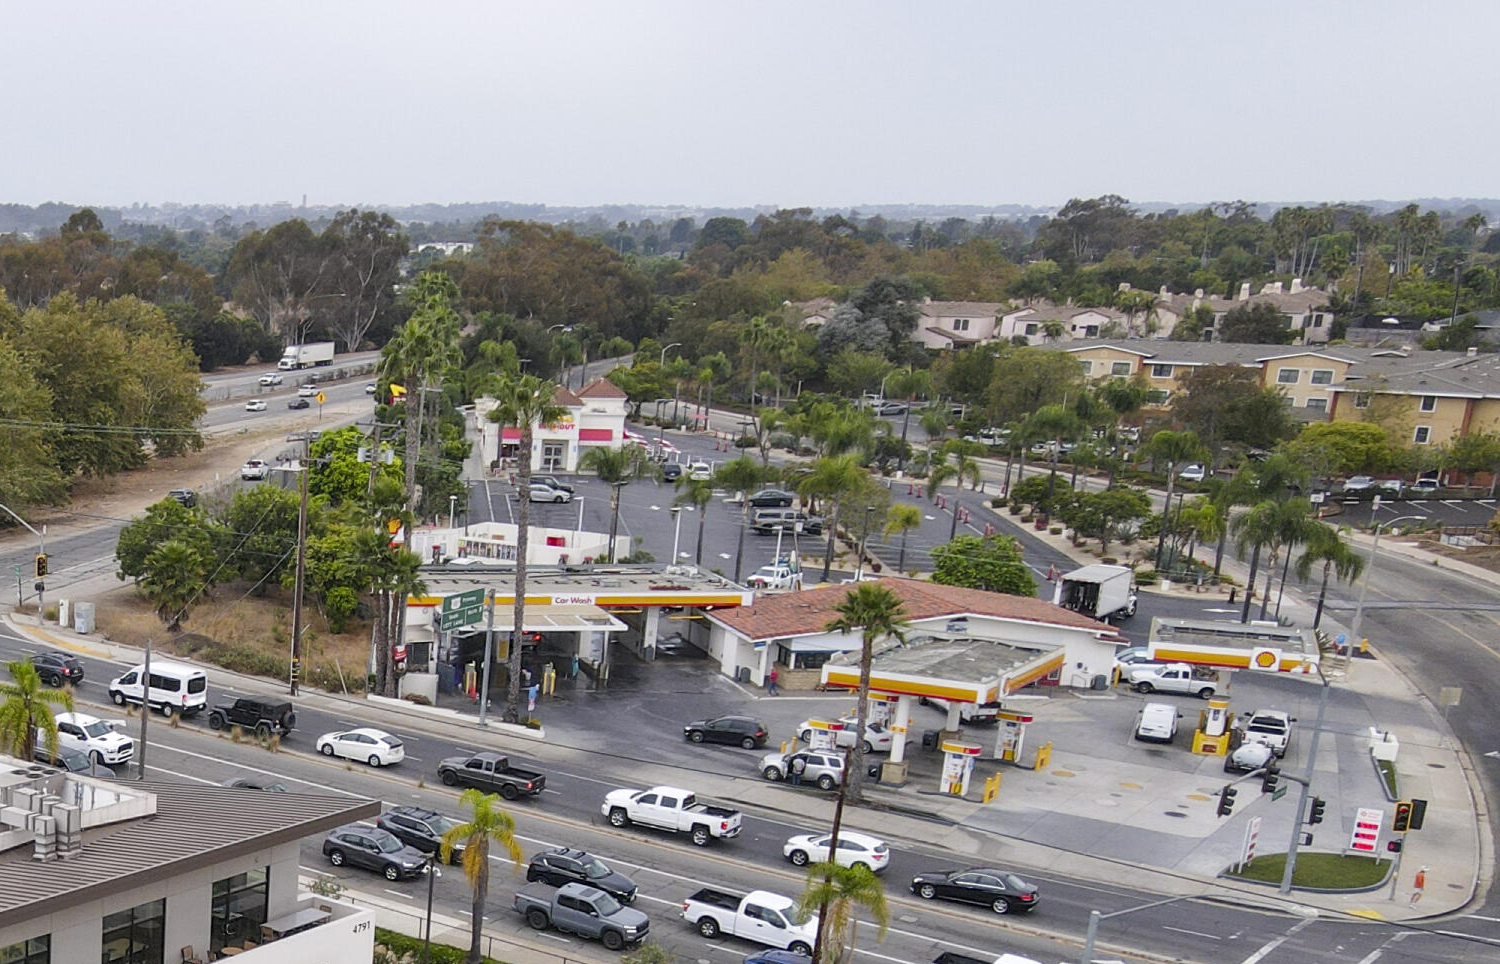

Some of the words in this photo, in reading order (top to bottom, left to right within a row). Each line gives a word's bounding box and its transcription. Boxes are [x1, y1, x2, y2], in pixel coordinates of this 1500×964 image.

[556, 596, 568, 604] Car
[571, 595, 592, 604] Wash
[353, 920, 371, 933] 4791
